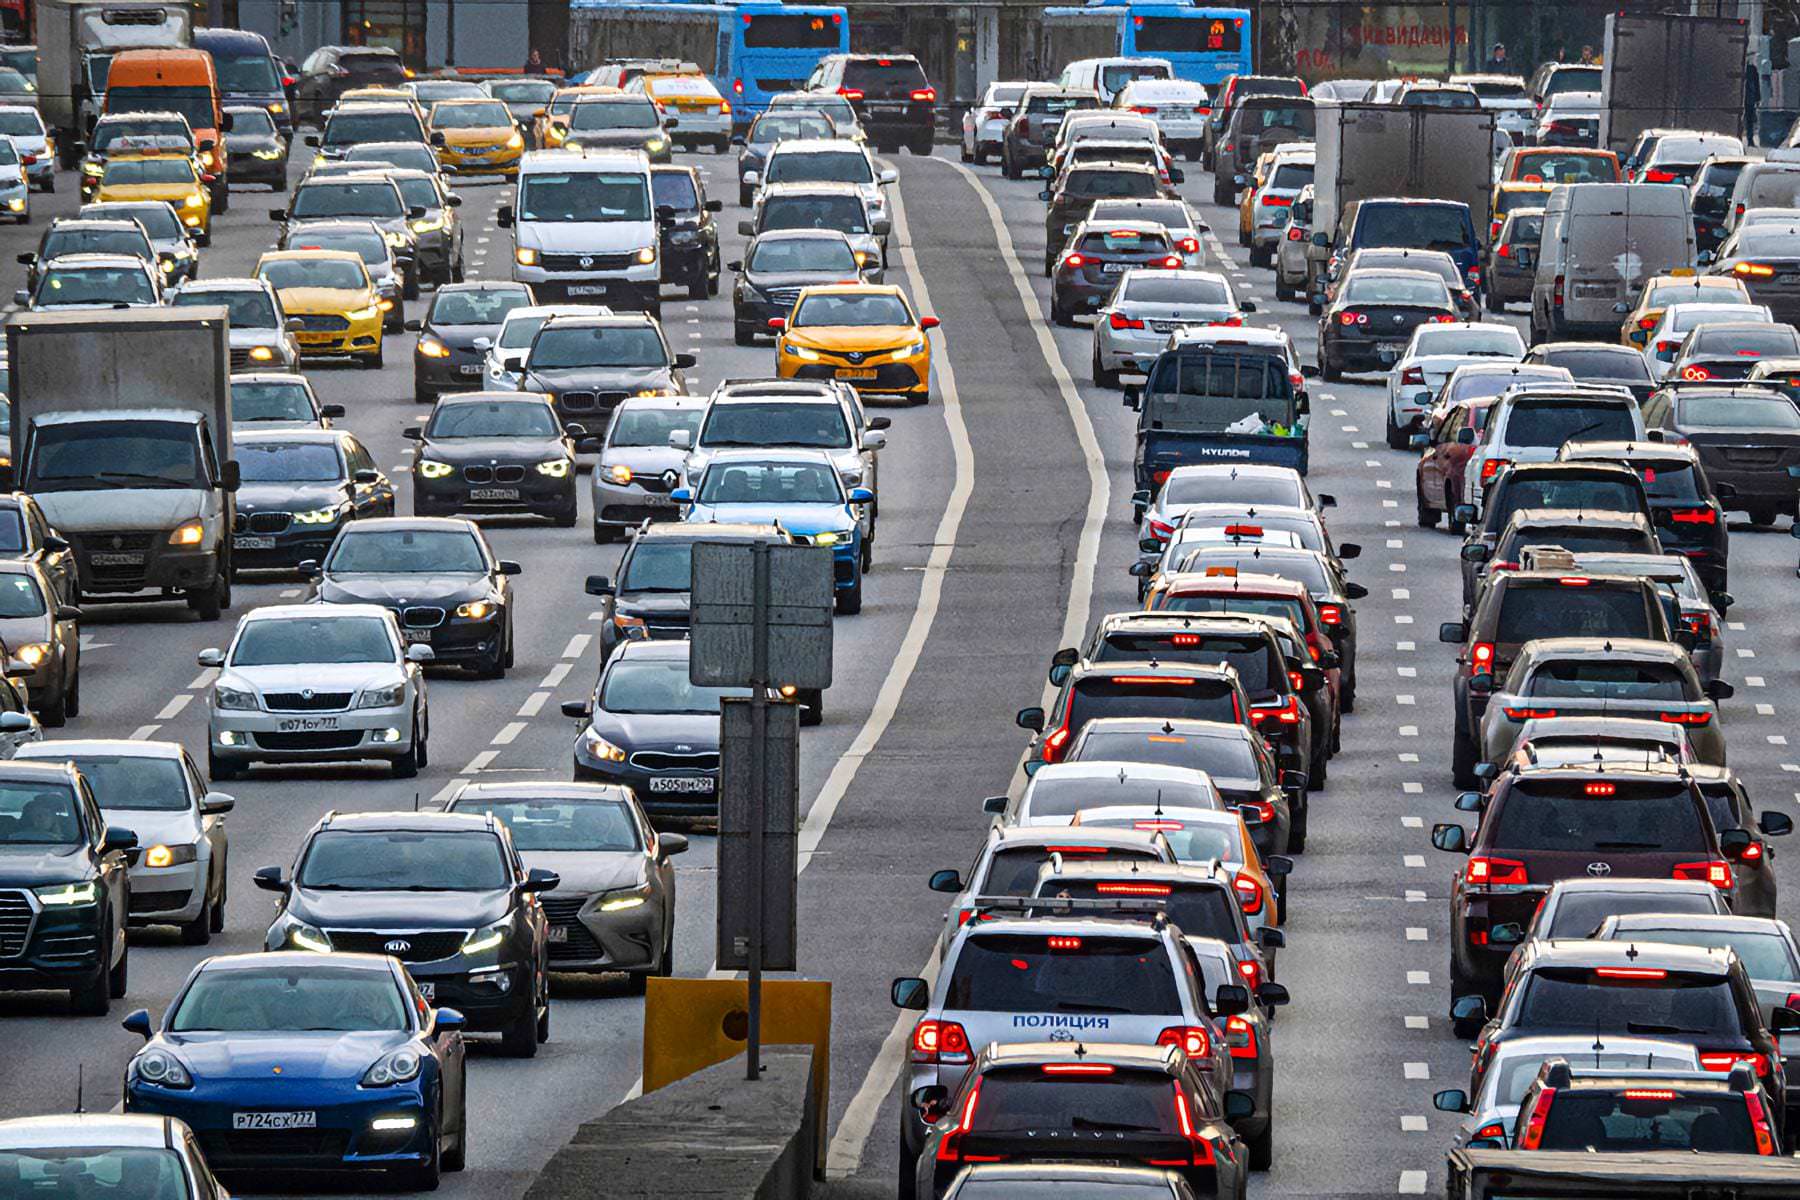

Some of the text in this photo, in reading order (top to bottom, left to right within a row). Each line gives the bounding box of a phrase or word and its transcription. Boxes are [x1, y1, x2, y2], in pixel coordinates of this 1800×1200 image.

[386, 941, 408, 951] KIA
[1013, 1015, 1109, 1030] ПОЛИЦИЯ
[1027, 1130, 1125, 1139] VOLVO
